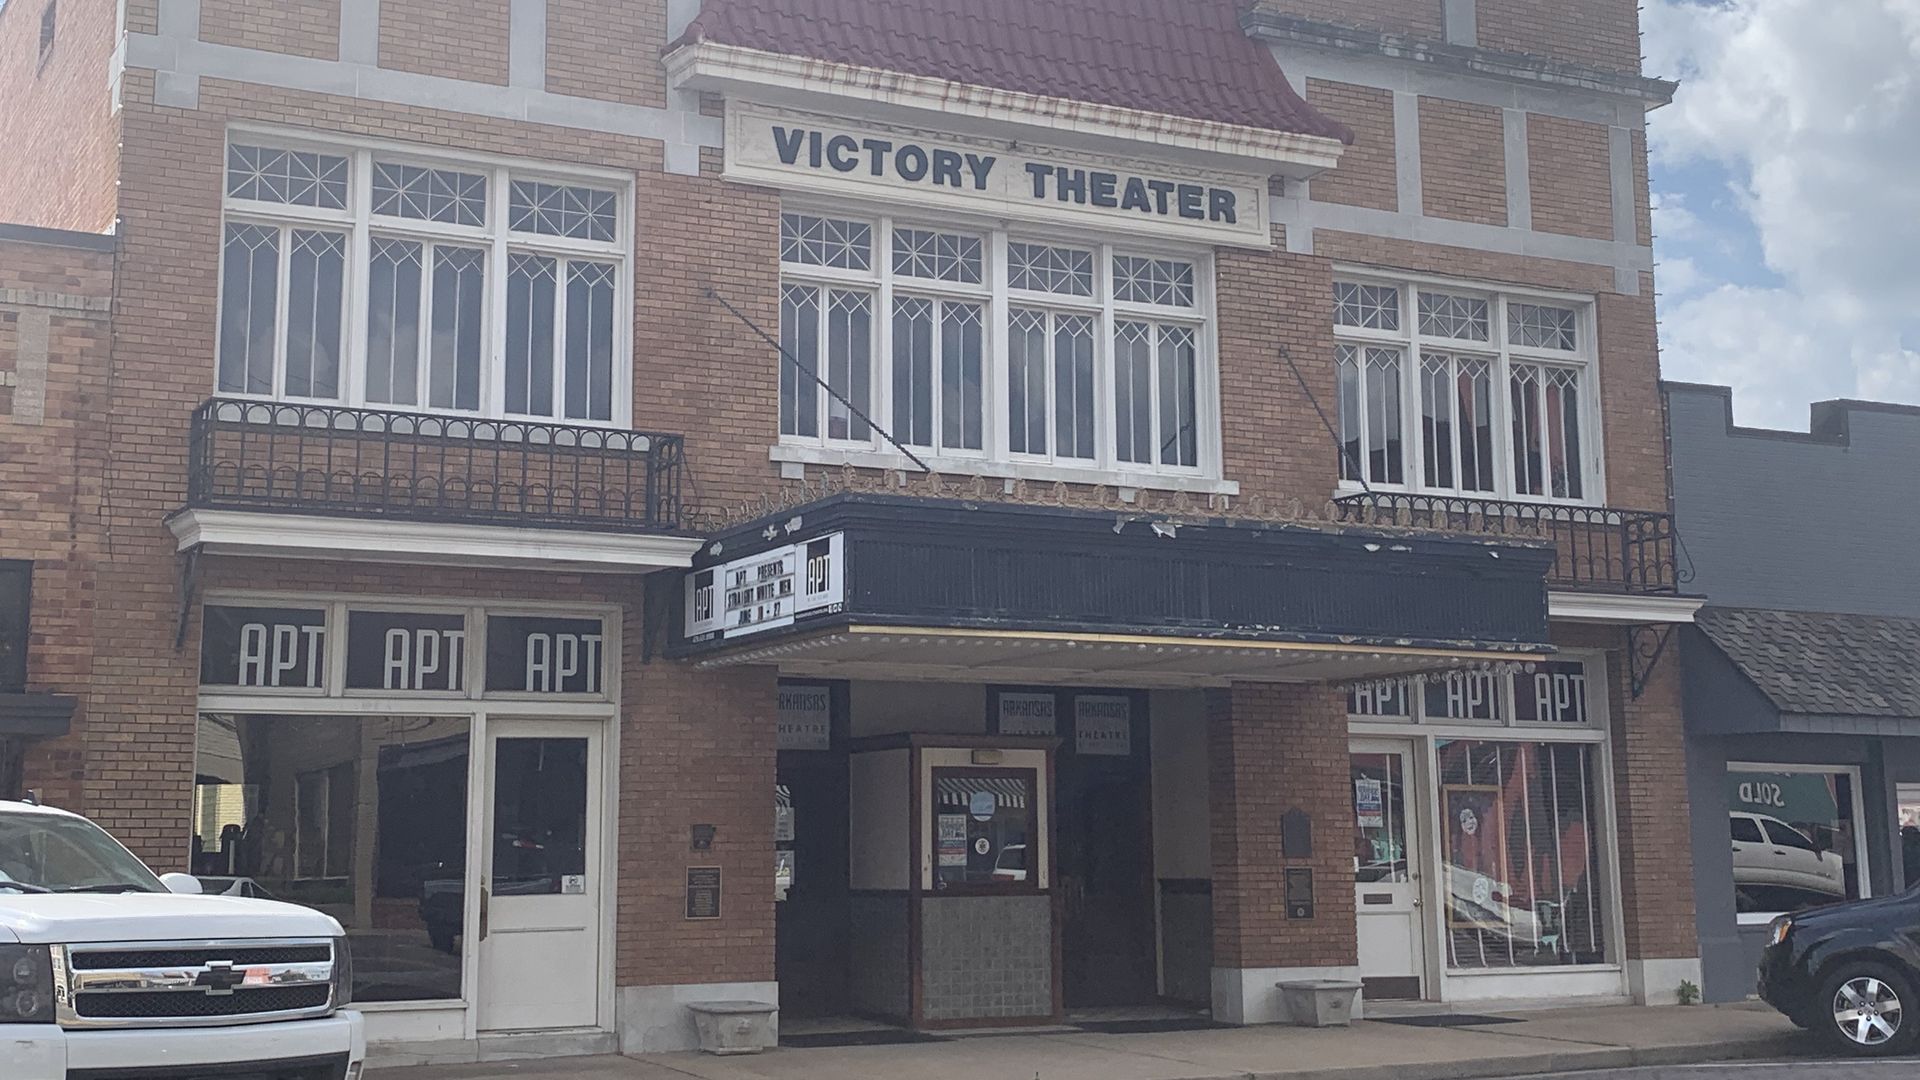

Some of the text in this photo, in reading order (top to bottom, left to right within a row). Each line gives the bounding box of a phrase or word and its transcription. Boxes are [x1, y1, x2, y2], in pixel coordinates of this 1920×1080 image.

[772, 126, 1238, 224] VICTORY THEATER
[757, 560, 783, 580] PRESENTS
[806, 554, 831, 596] APT
[695, 586, 714, 623] APT
[728, 588, 754, 608] STRAIGHT
[238, 623, 325, 688] APT
[384, 628, 464, 690] APT
[526, 633, 602, 693] APT
[777, 692, 826, 711] RKANSAS
[1003, 700, 1053, 717] ARKANSAS
[1078, 702, 1127, 719] ARKANSAS
[1447, 670, 1496, 720] APT
[1534, 673, 1585, 722] APT
[778, 724, 826, 734] HEATRE
